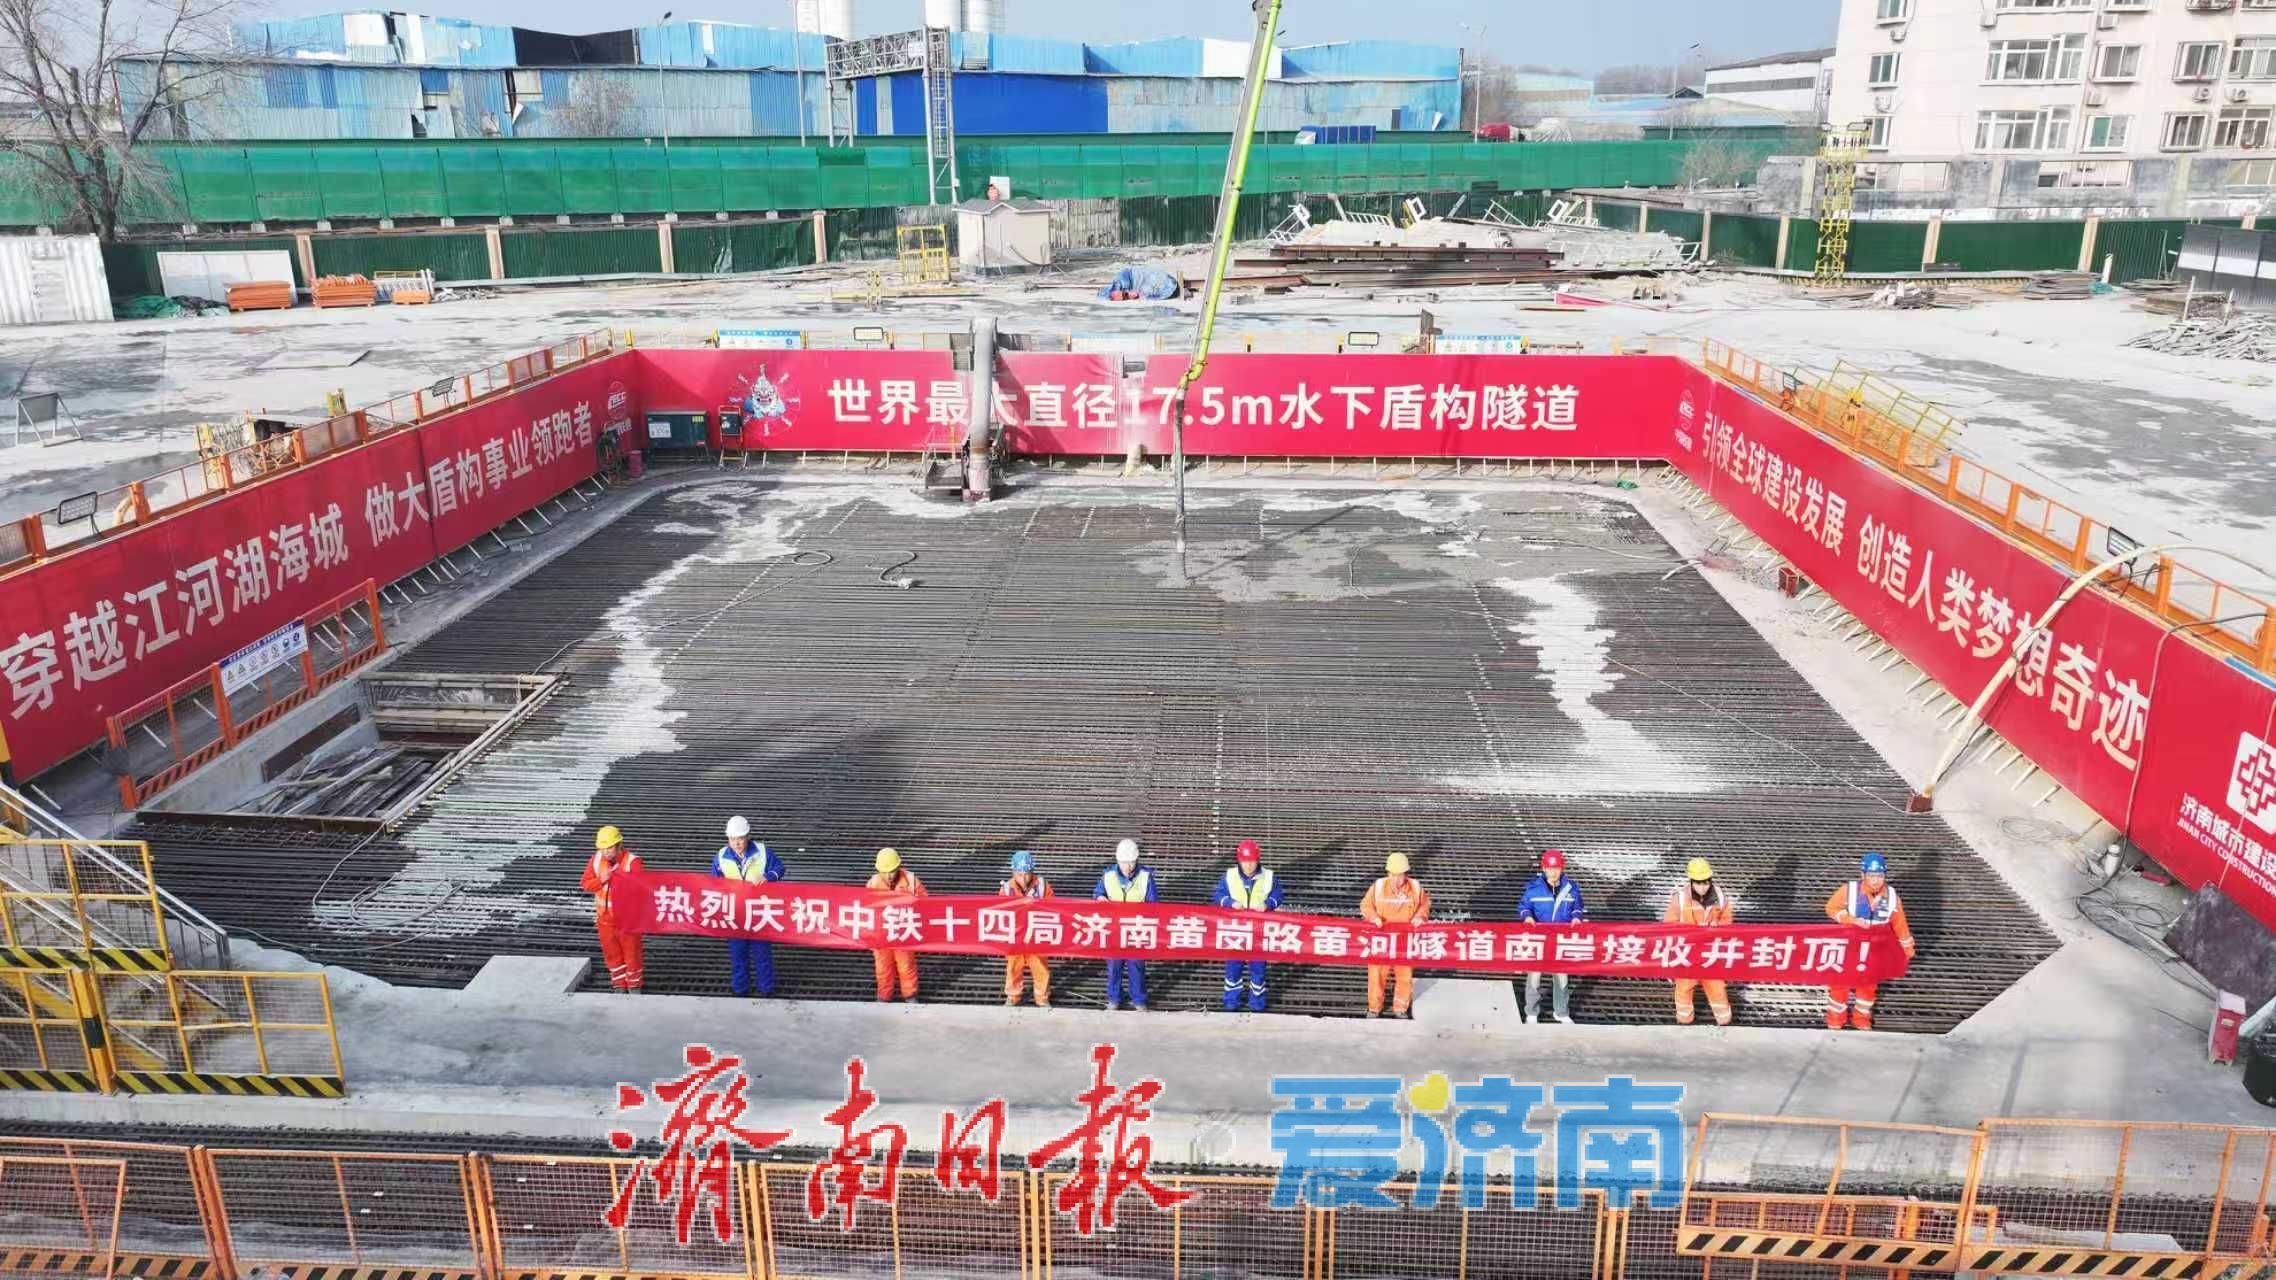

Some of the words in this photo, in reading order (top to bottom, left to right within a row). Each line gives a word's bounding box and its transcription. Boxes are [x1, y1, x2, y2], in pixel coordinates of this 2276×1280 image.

[0, 502, 348, 720] 穿越江河湖海城
[365, 401, 592, 546] 做大盾构事业领跑者
[1702, 411, 1847, 556] 引领全球建设发展
[1858, 514, 2151, 772] 创造人类梦想奇迹
